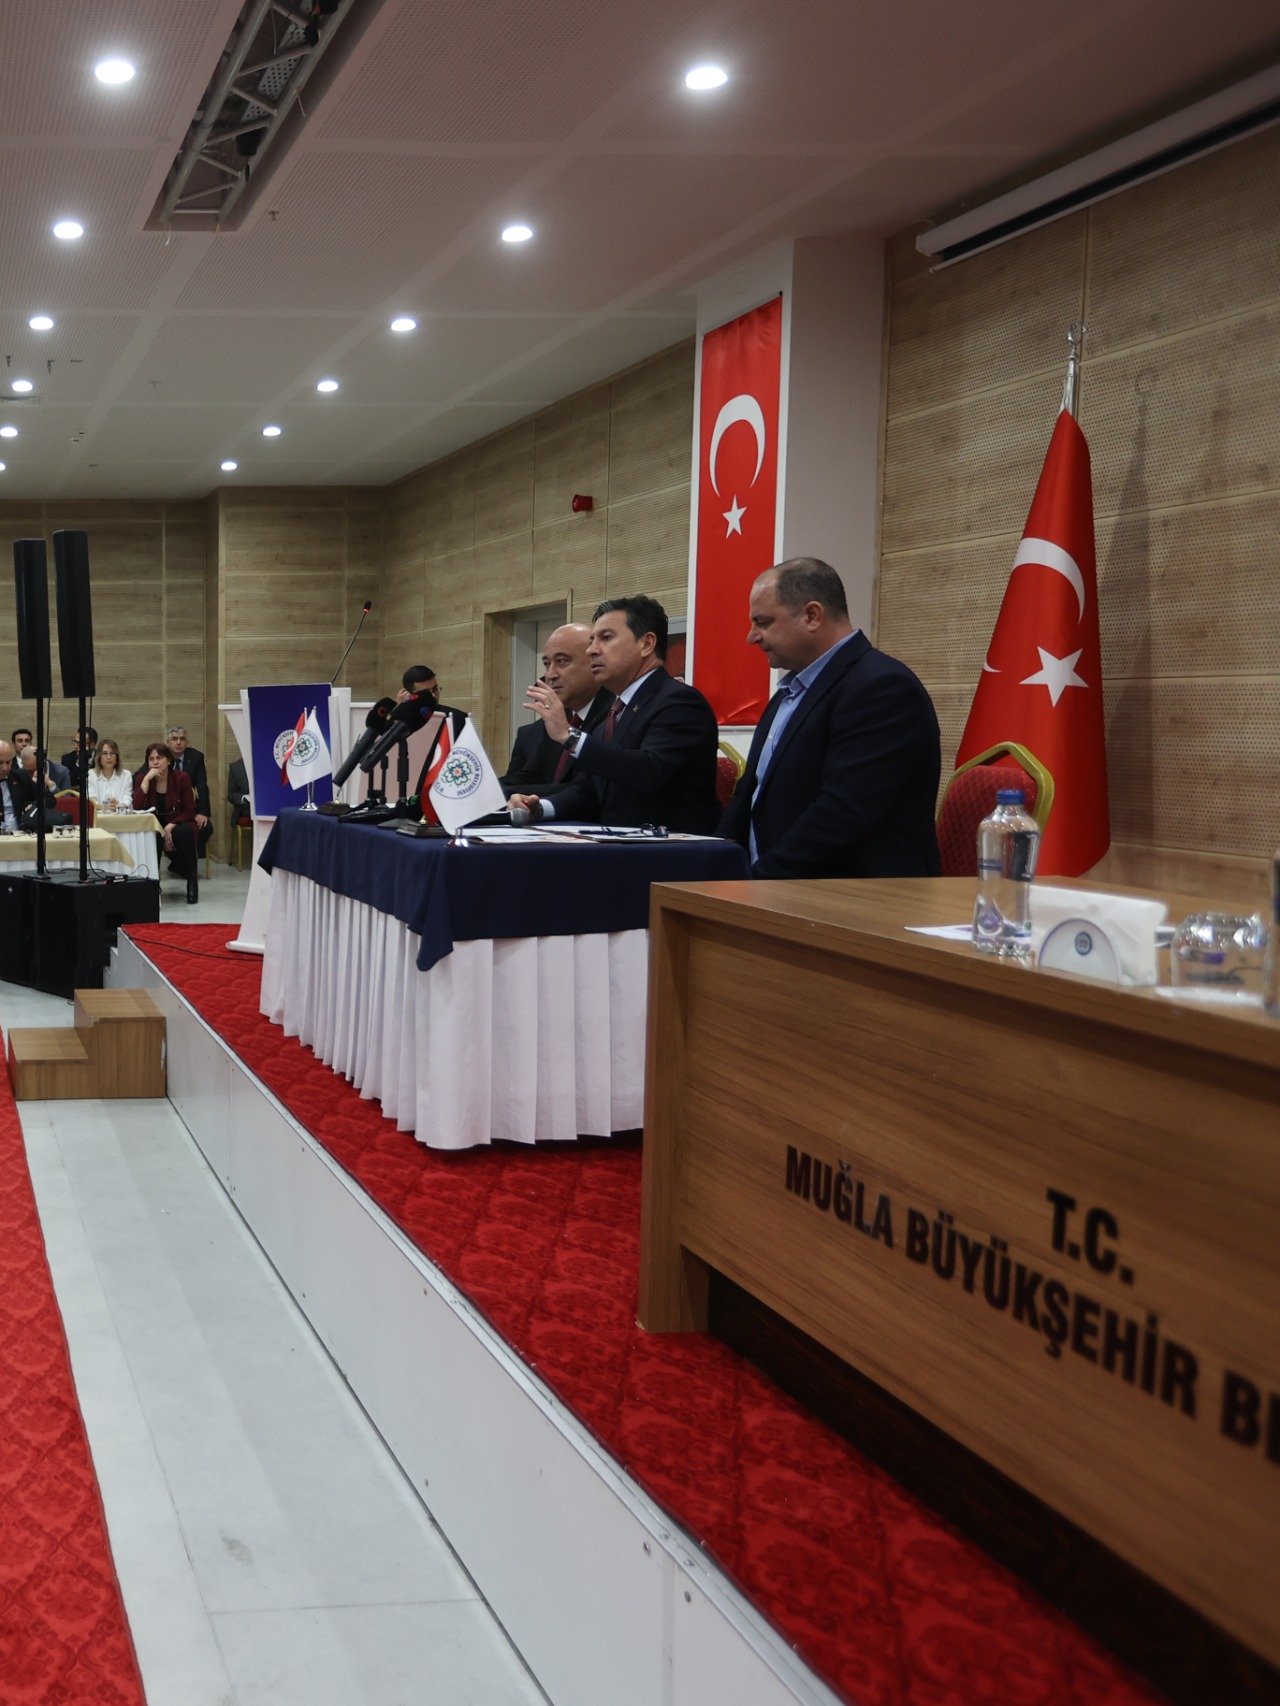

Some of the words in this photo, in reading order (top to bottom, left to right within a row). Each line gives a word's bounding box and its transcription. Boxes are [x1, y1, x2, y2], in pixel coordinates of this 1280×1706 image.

[785, 1144, 894, 1250] MUĞLA
[905, 1206, 1199, 1422] BÜYÜKŞEHİR
[1046, 1187, 1135, 1286] T.C.
